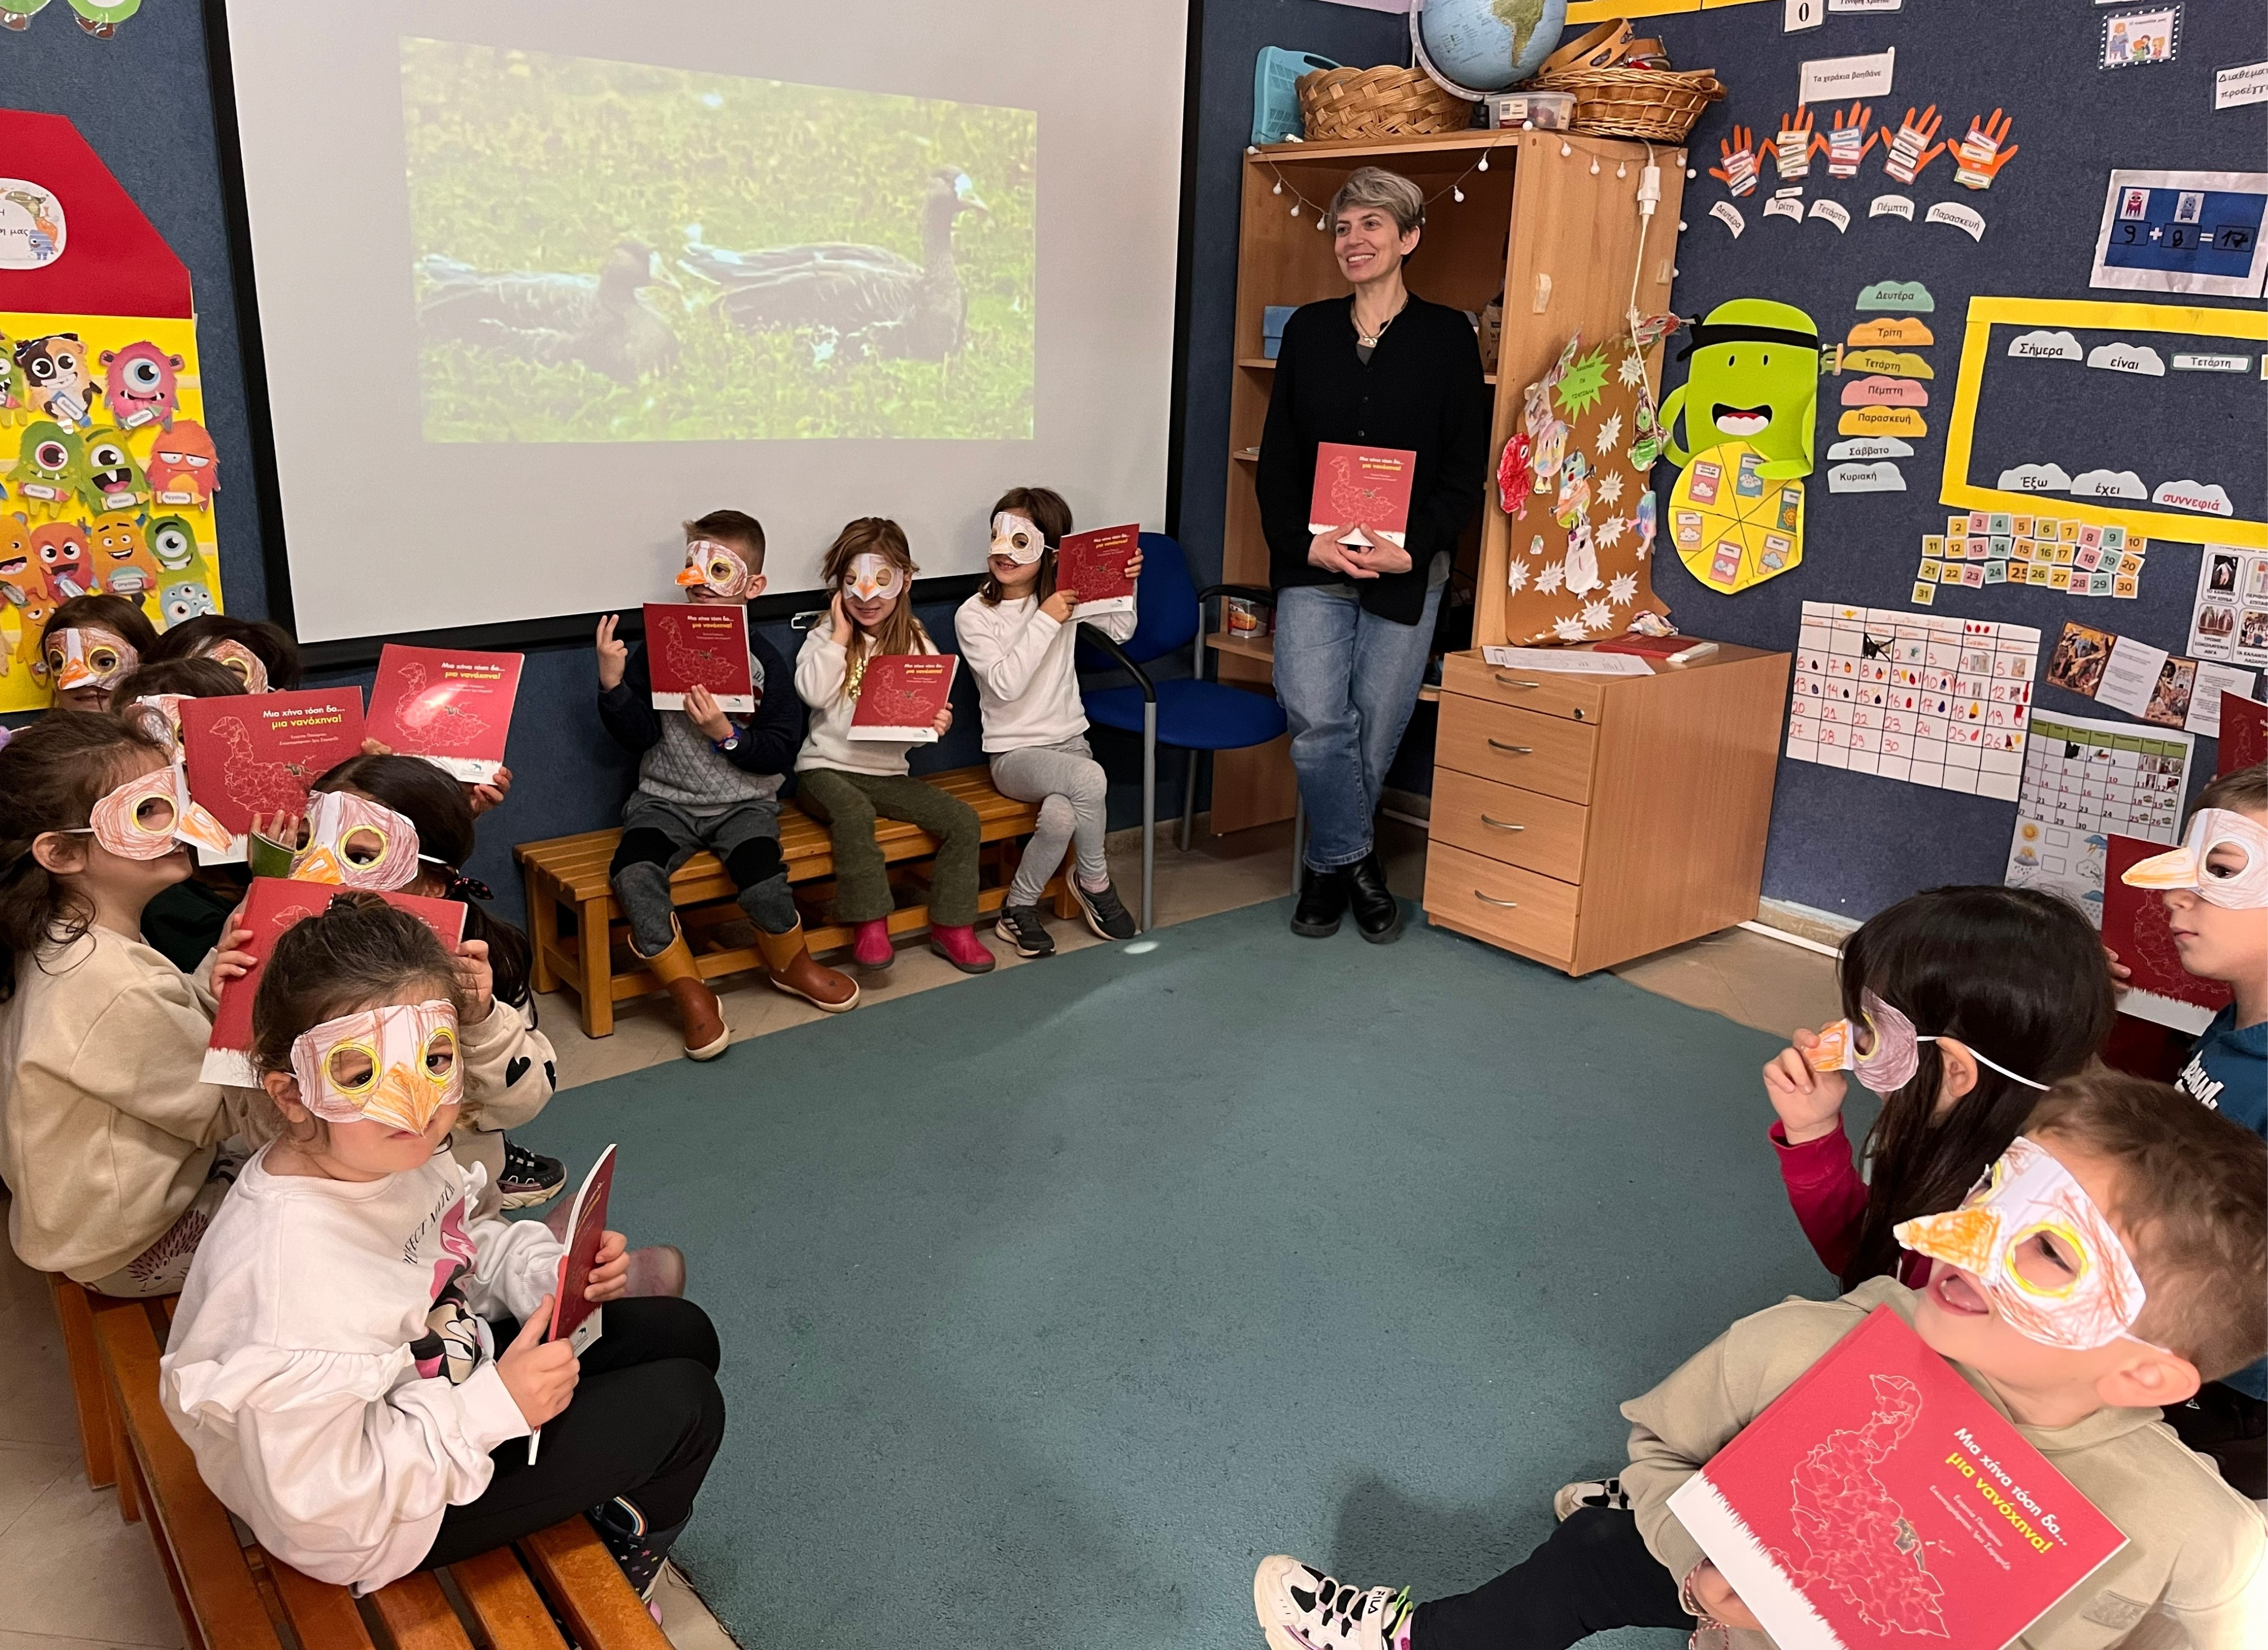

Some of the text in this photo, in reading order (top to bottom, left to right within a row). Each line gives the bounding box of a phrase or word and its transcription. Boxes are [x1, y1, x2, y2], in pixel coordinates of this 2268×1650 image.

[1823, 74, 1850, 82] χεράκια
[1851, 70, 1881, 80] βοηθάνε
[1716, 204, 1742, 228] Δευτέρα
[1775, 200, 1794, 213] Τρίτη
[1817, 203, 1846, 224] Τετάρτη
[1876, 202, 1908, 214] Πέμπτη
[1932, 208, 1981, 231] Παρασκευή
[2125, 225, 2136, 244] 9
[2172, 230, 2183, 247] 8
[1876, 291, 1914, 301] Δευτέρα
[1878, 328, 1902, 339] Τρίτη
[1865, 358, 1901, 372] Τετάρτη
[2019, 343, 2231, 369] Σήμερα είναι Τετάρτη
[1868, 386, 1903, 395] Πέμπτη
[1858, 413, 1911, 425] Παρασκευή
[1850, 447, 1889, 456] Σάββατο
[1840, 471, 1876, 481] Κυριακή
[2020, 476, 2221, 511] Έξω έχει συννεφιά
[2128, 538, 2140, 547] 10
[2019, 545, 2029, 553] 15
[2041, 548, 2051, 557] 16
[2058, 549, 2068, 558] 17
[2084, 554, 2095, 563] 18
[2105, 556, 2115, 565] 19
[2122, 560, 2136, 571] 20
[1925, 566, 1935, 574] 21
[1966, 571, 1979, 580] 23
[1989, 568, 2001, 576] 24
[2032, 570, 2045, 578] 26
[2093, 580, 2107, 589] 29
[2118, 583, 2132, 591] 30
[1918, 589, 1928, 598] 31
[1894, 649, 2005, 675] 2 3 4 5
[1797, 657, 2005, 701] 6 7 8 9 10 11 12
[305, 706, 324, 715] τόση
[1794, 677, 2003, 725] 13 14 15 16 17 18 19
[272, 714, 341, 731] μια νανόχηνα!
[1792, 701, 2001, 749] 20 21 22 23 24 25 26
[1790, 721, 1899, 752] 27 28 29 30
[1954, 1427, 2068, 1546] Μια χήνα τόση δα...
[1945, 1452, 1976, 1478] μια
[1976, 1477, 2054, 1553] νανόχηνα!
[1368, 1591, 1386, 1614] FILA
